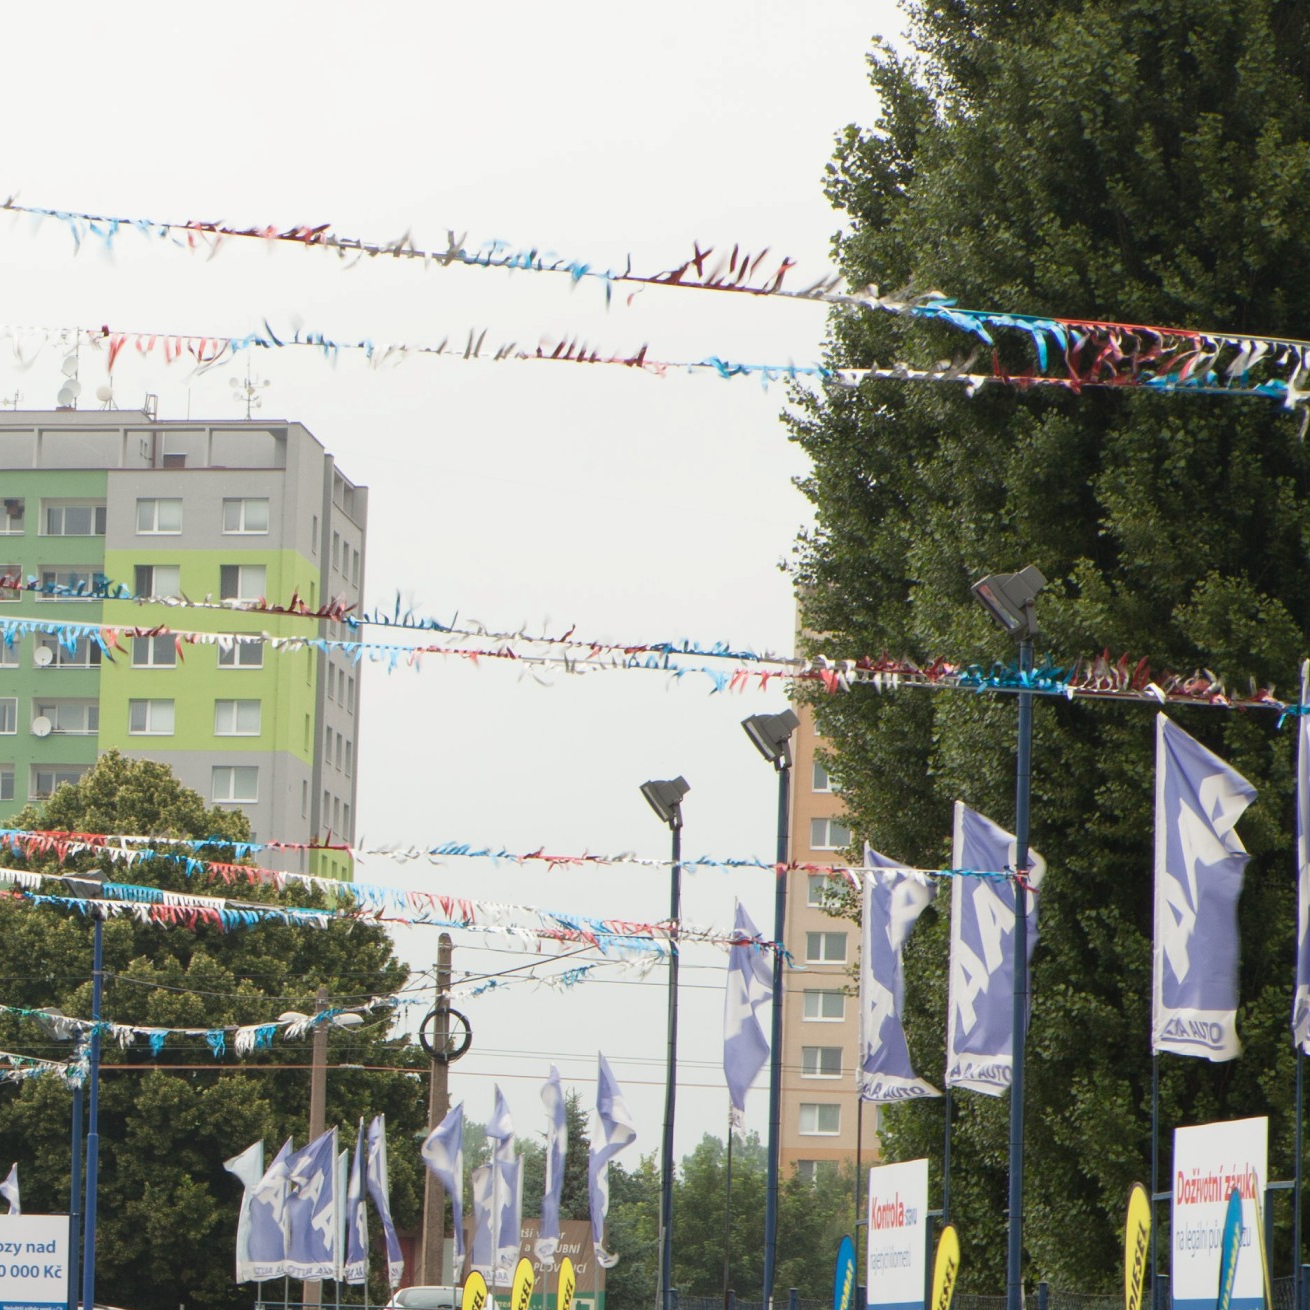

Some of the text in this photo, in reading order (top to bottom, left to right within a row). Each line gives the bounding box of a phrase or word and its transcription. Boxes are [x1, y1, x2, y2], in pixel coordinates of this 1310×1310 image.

[871, 1192, 904, 1230] Kontrola
[26, 1240, 56, 1254] nad
[10, 1265, 40, 1278] 000
[44, 1265, 62, 1279] Kč
